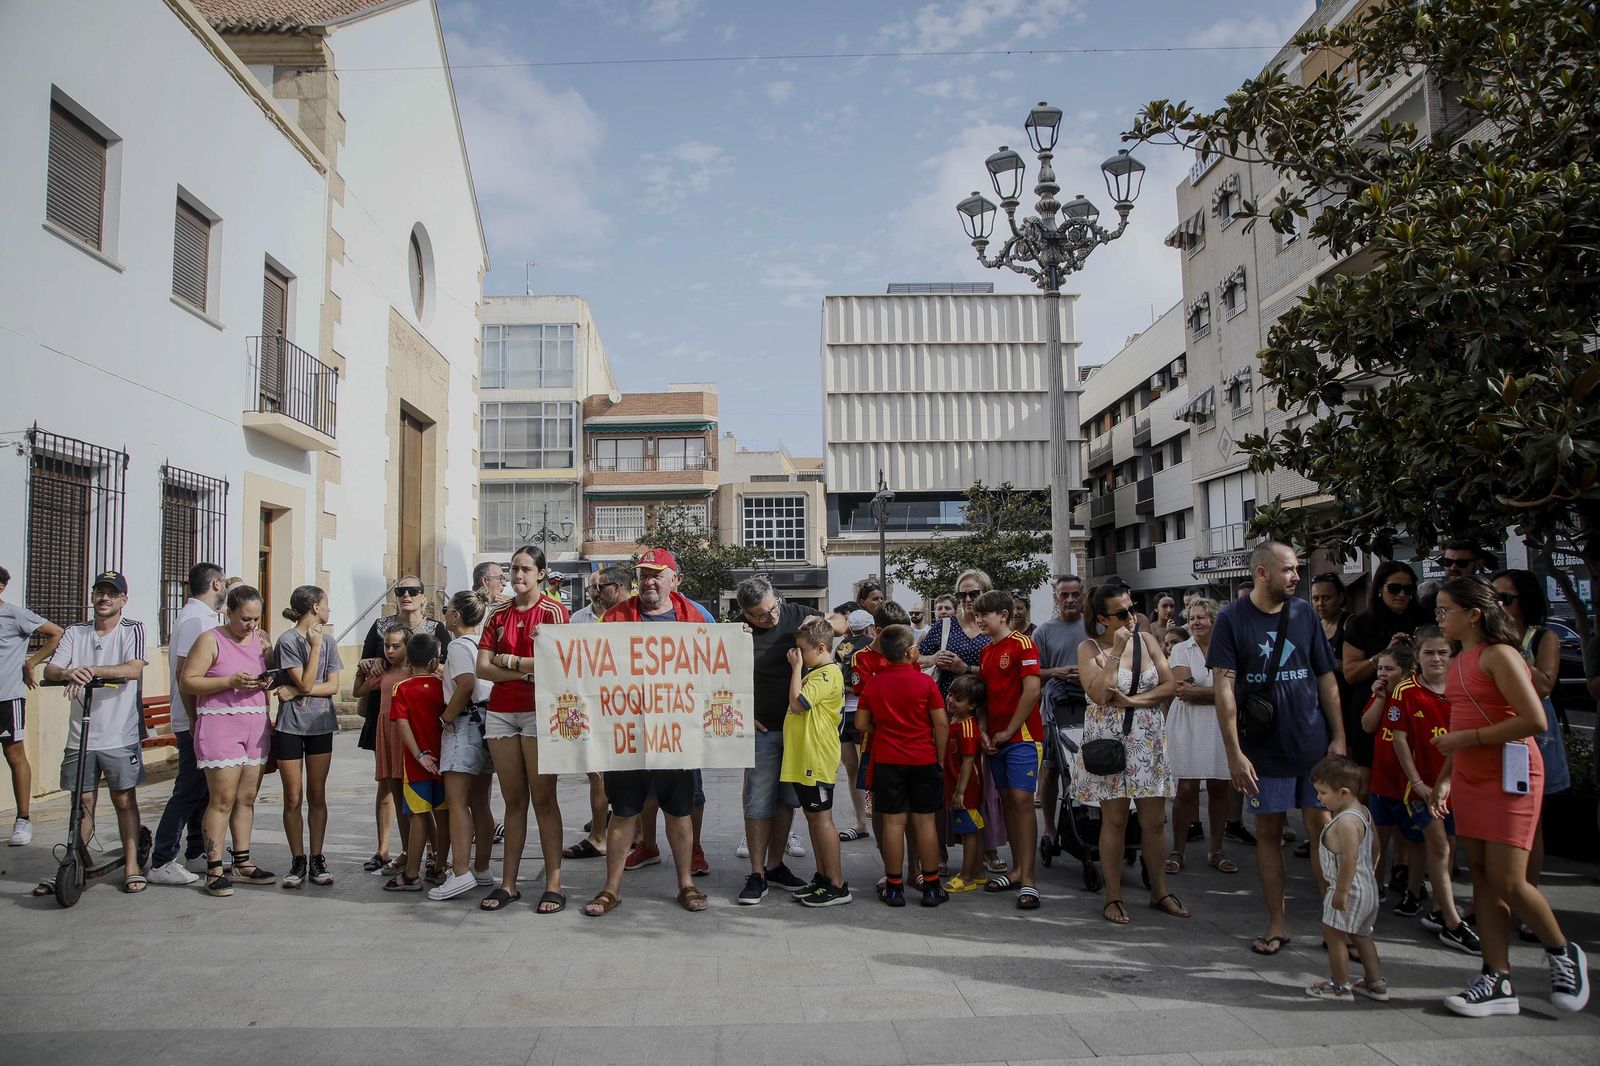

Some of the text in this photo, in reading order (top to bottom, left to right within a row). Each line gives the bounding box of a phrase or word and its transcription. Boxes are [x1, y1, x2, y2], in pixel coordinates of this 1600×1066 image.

[555, 627, 732, 679] VIVA ESPAÑA
[600, 681, 696, 717] ROQUETAS
[613, 721, 684, 755] DE MAR
